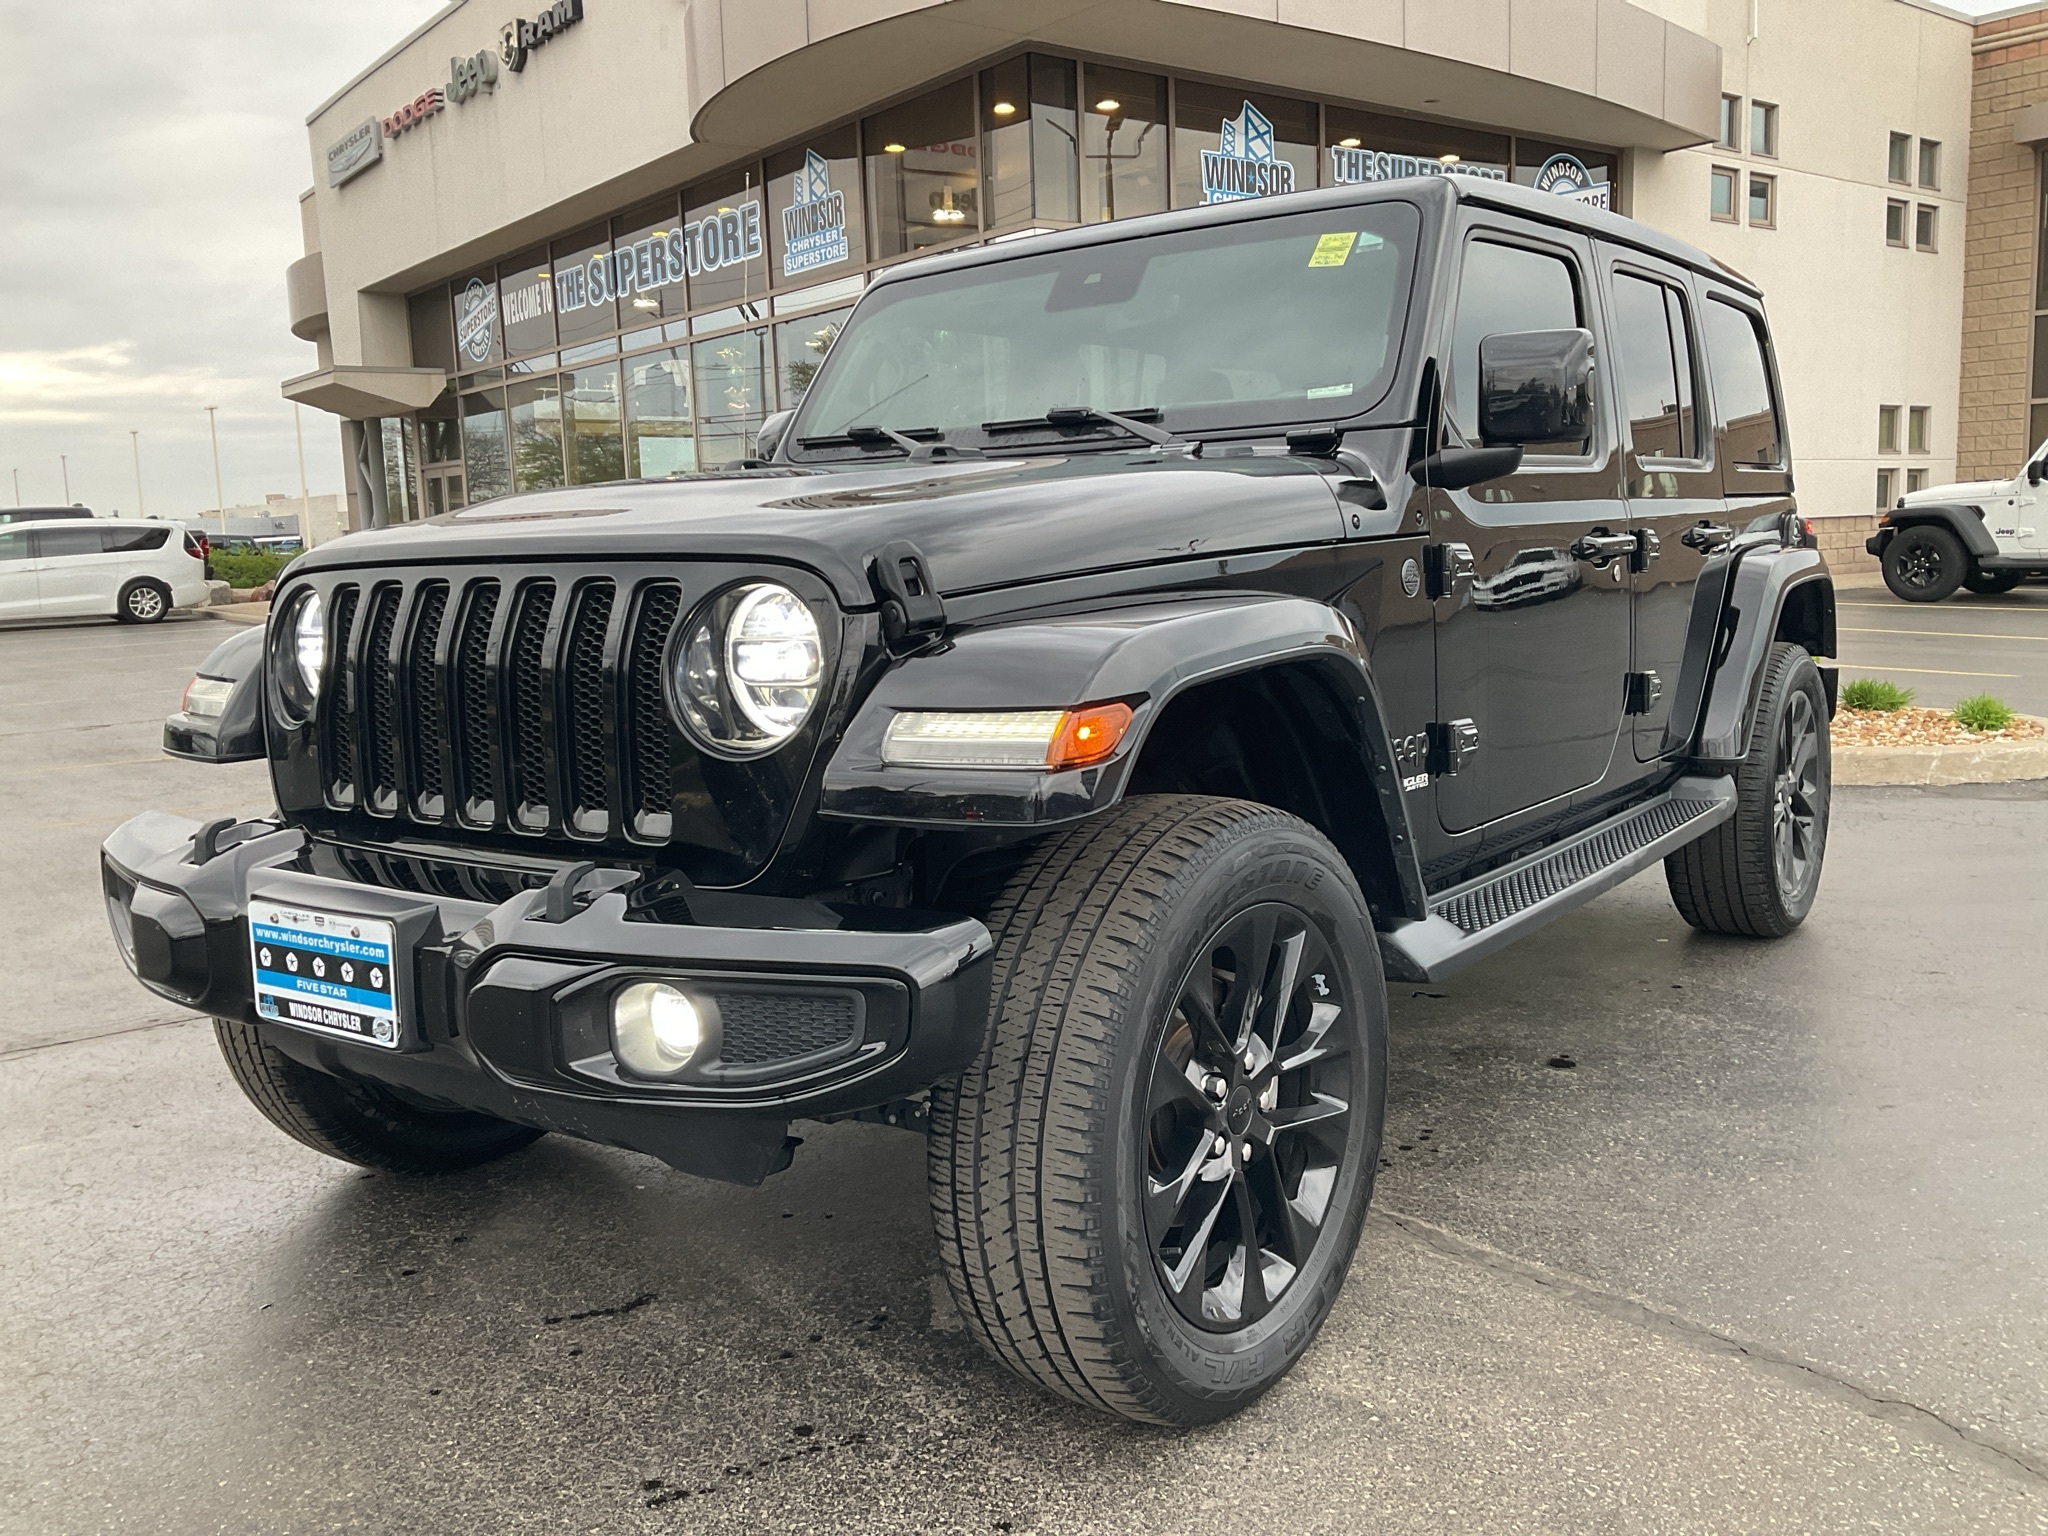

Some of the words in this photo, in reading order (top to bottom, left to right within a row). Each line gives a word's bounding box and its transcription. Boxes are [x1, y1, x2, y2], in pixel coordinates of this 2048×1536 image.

[521, 0, 579, 49] RAM
[446, 49, 493, 104] Jeep
[383, 88, 441, 139] DODGE
[328, 125, 371, 161] CHRYSLER
[1203, 154, 1292, 196] WINDSOR
[1333, 148, 1374, 182] THE
[1540, 162, 1583, 190] WINDSOR
[785, 194, 844, 241] WINDSOR
[786, 242, 846, 271] SUPERSTORE
[791, 229, 838, 253] CHRYSLER
[502, 283, 542, 326] WELCOME
[541, 280, 552, 313] TO
[556, 266, 586, 312] THE
[588, 202, 761, 305] SUPERSTORE
[459, 297, 496, 342] SUPERSTORE
[1995, 528, 2015, 536] Jeep
[255, 927, 385, 958] www.windsorchrysler.com
[296, 980, 318, 993] FIVE
[320, 984, 347, 998] STAR
[288, 1002, 322, 1023] WINDSOR
[323, 1007, 361, 1031] CHRYSLER
